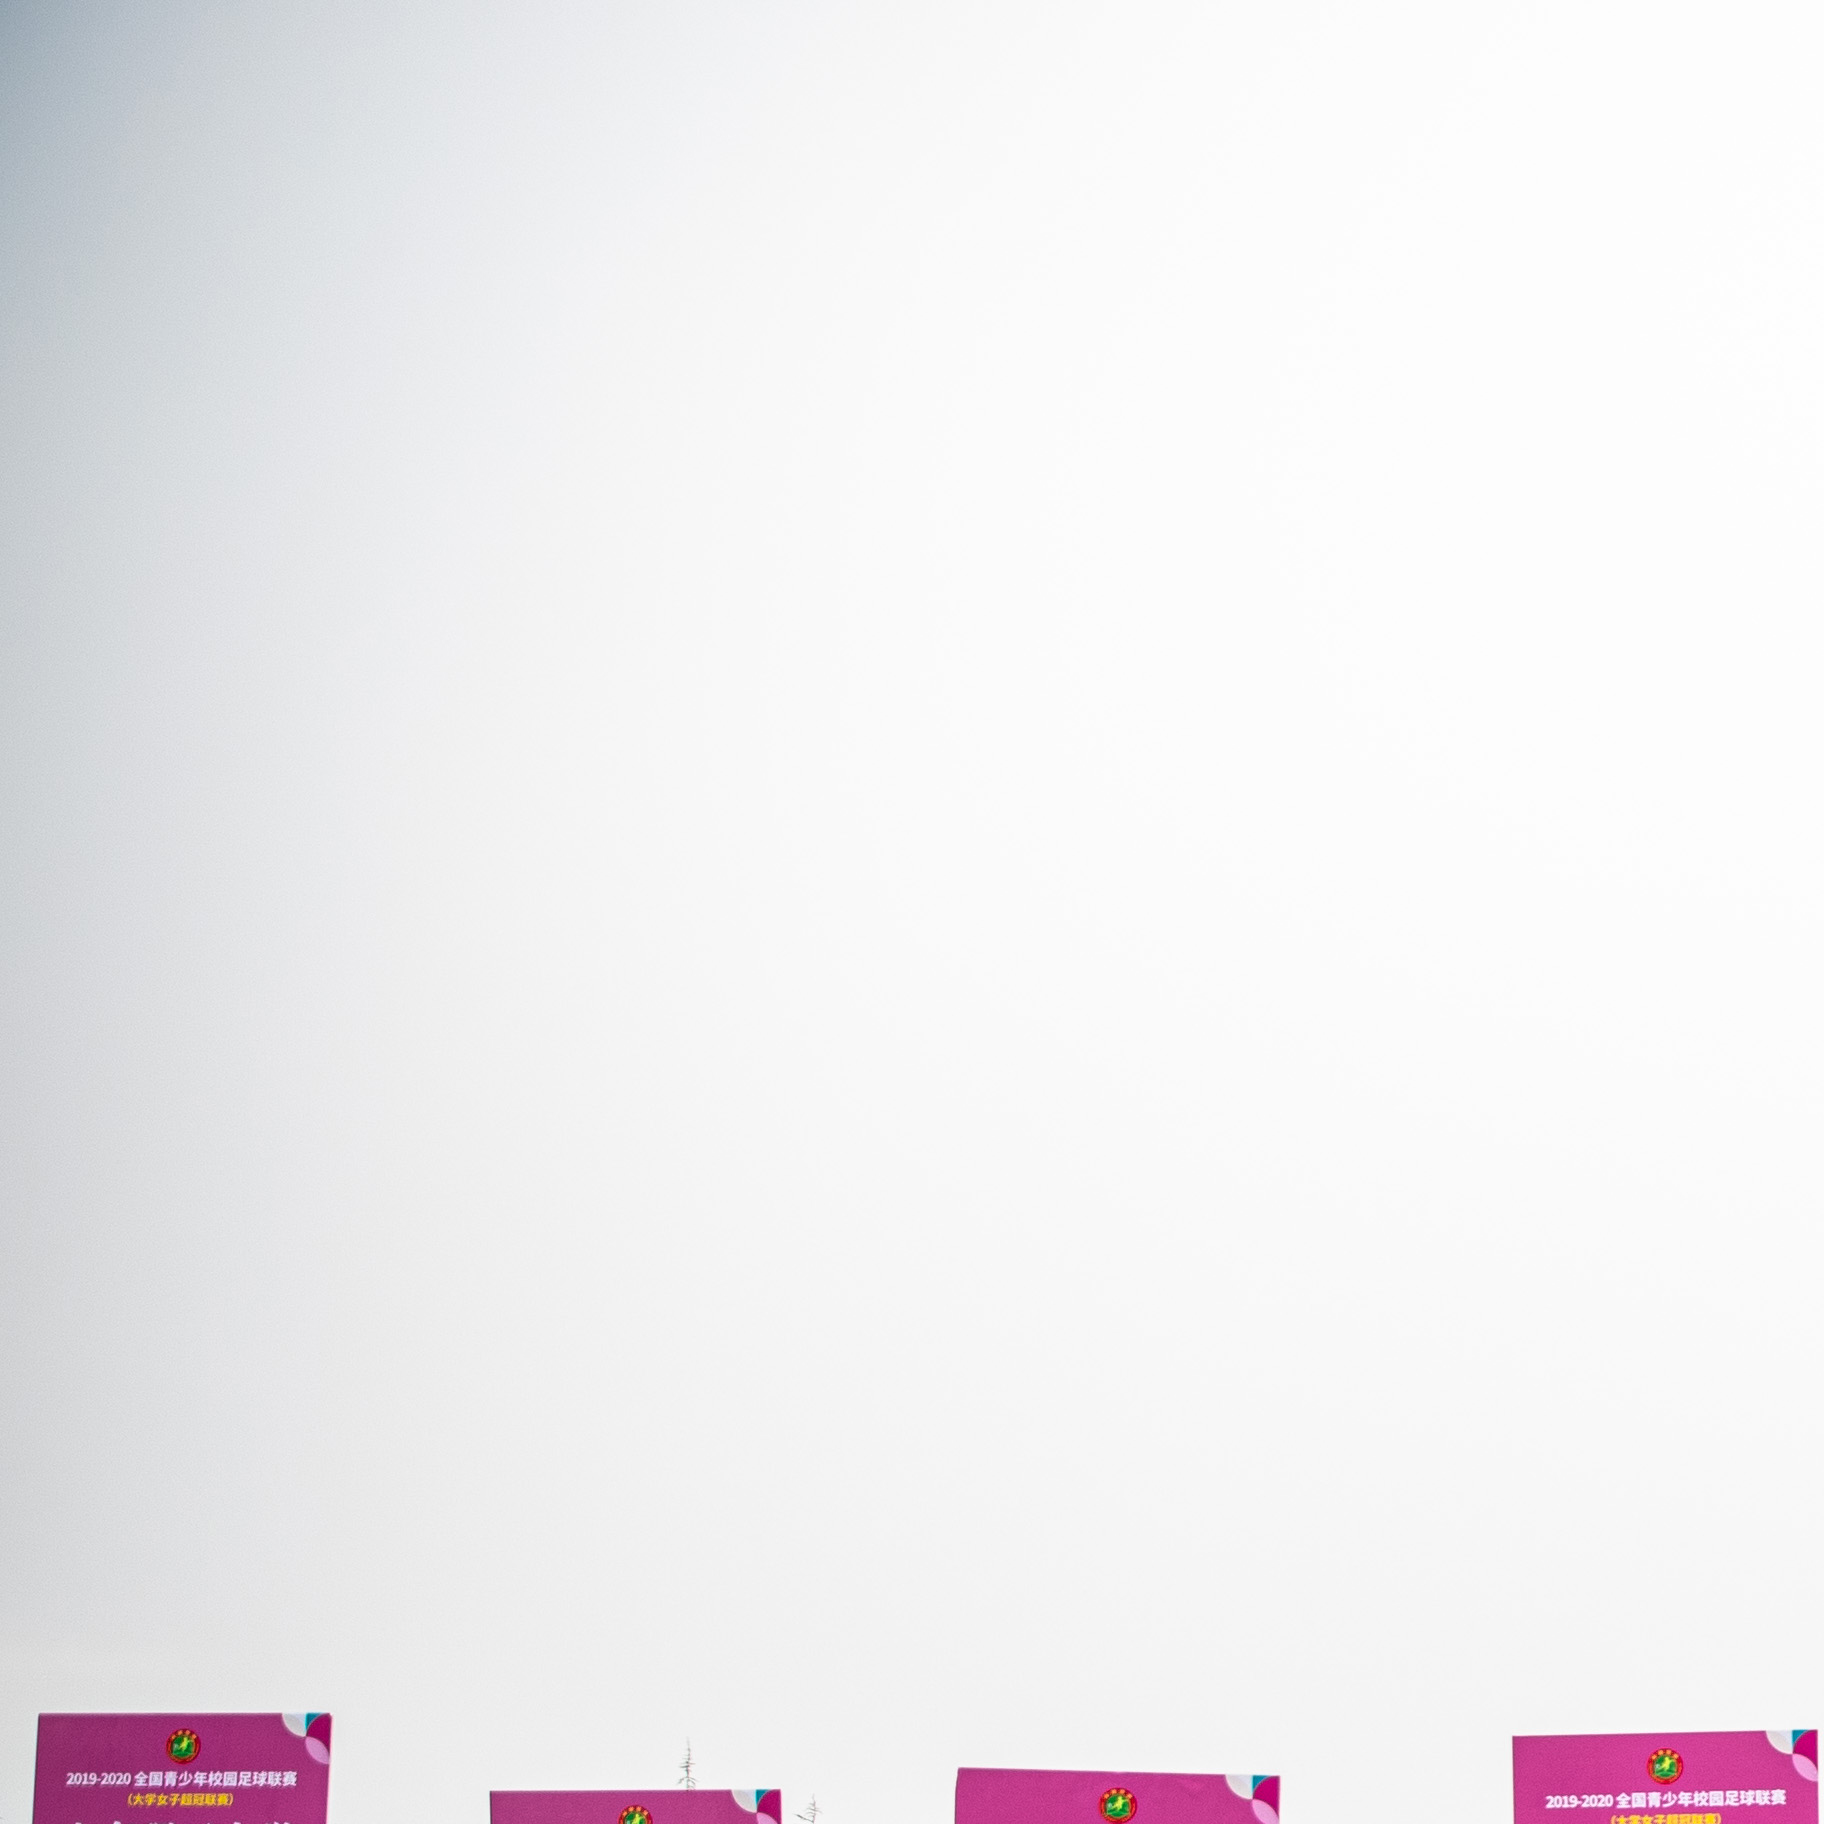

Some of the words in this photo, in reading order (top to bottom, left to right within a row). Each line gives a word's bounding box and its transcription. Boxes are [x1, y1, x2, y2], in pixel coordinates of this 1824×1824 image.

[66, 1773, 131, 1785] 2019-2020
[134, 1771, 297, 1787] 全国青少年校园足球联赛
[1546, 1794, 1614, 1808] 2019-2020
[1616, 1789, 1786, 1809] 全国青少年校园足球联赛
